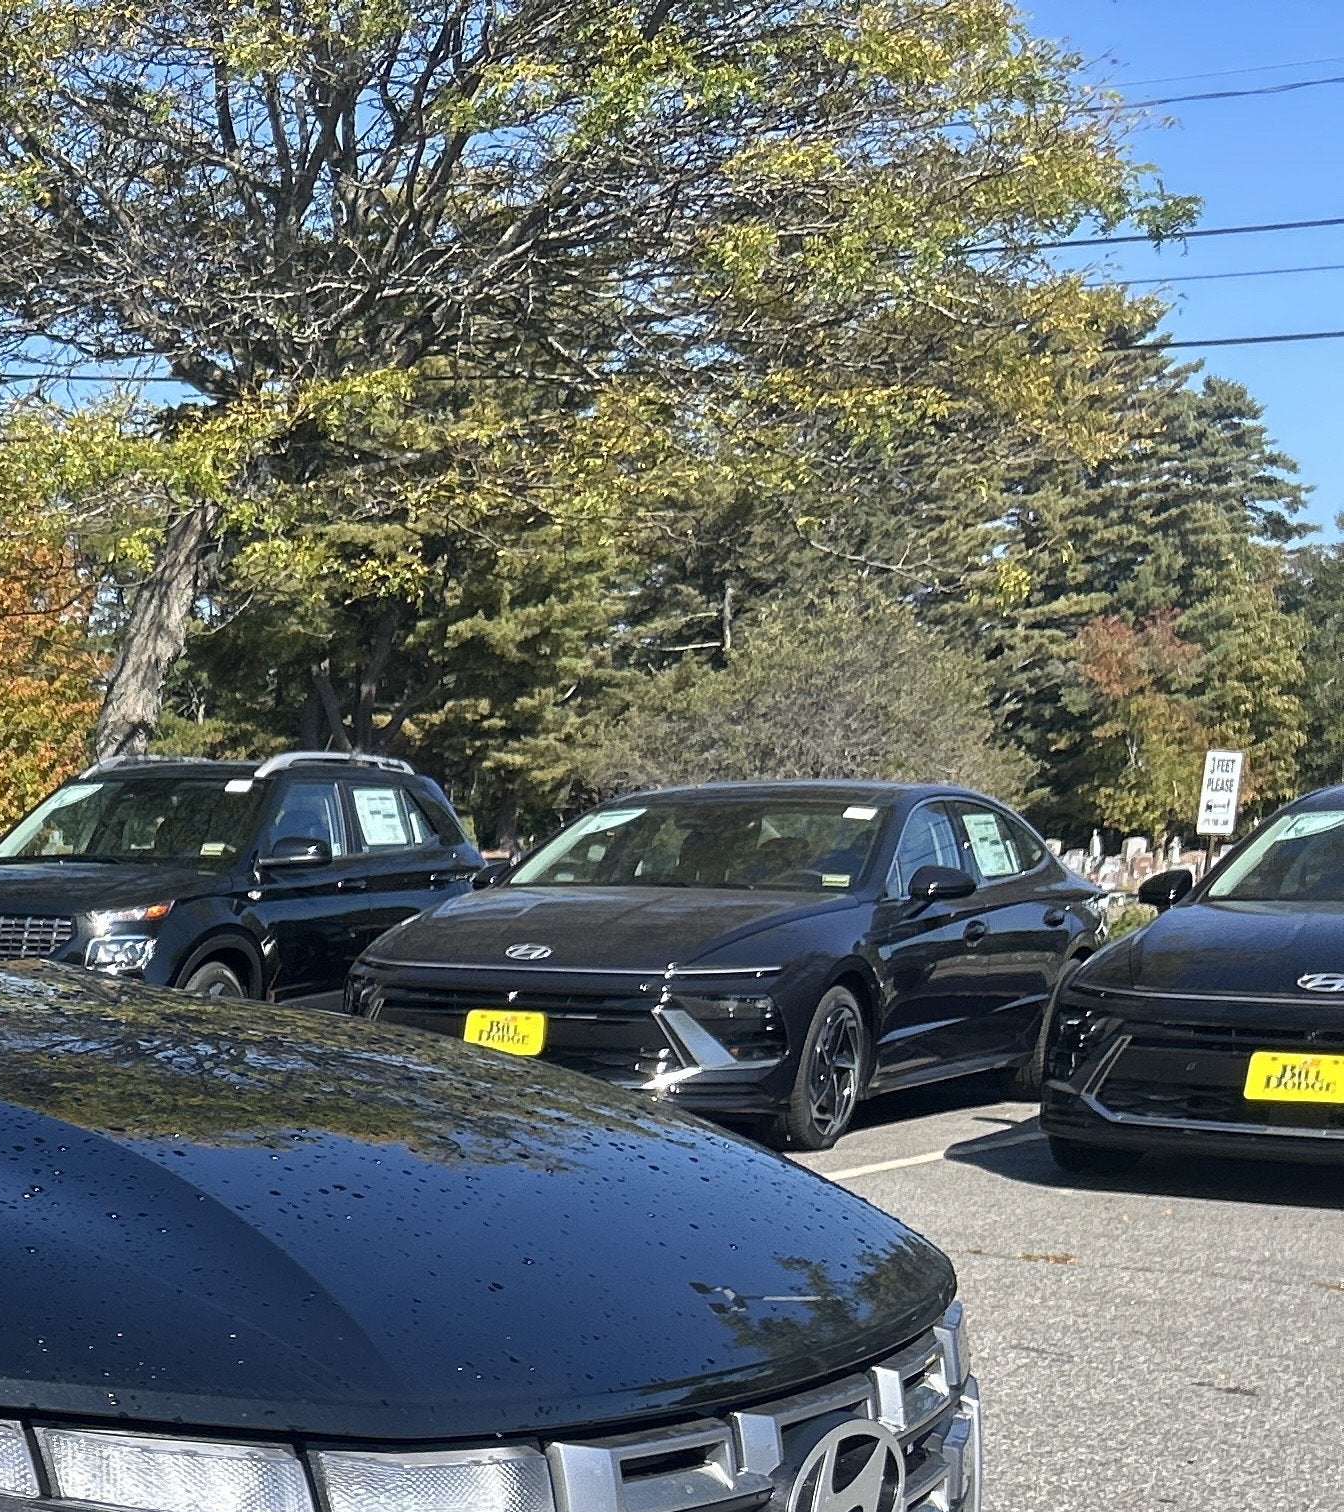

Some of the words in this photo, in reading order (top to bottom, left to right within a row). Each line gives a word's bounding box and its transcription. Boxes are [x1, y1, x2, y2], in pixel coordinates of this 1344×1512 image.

[1217, 758, 1236, 773] FEET
[1206, 777, 1235, 793] PLEASE
[489, 1020, 519, 1035] BILL
[478, 1029, 530, 1046] DODGE
[1280, 1064, 1324, 1082] BILL
